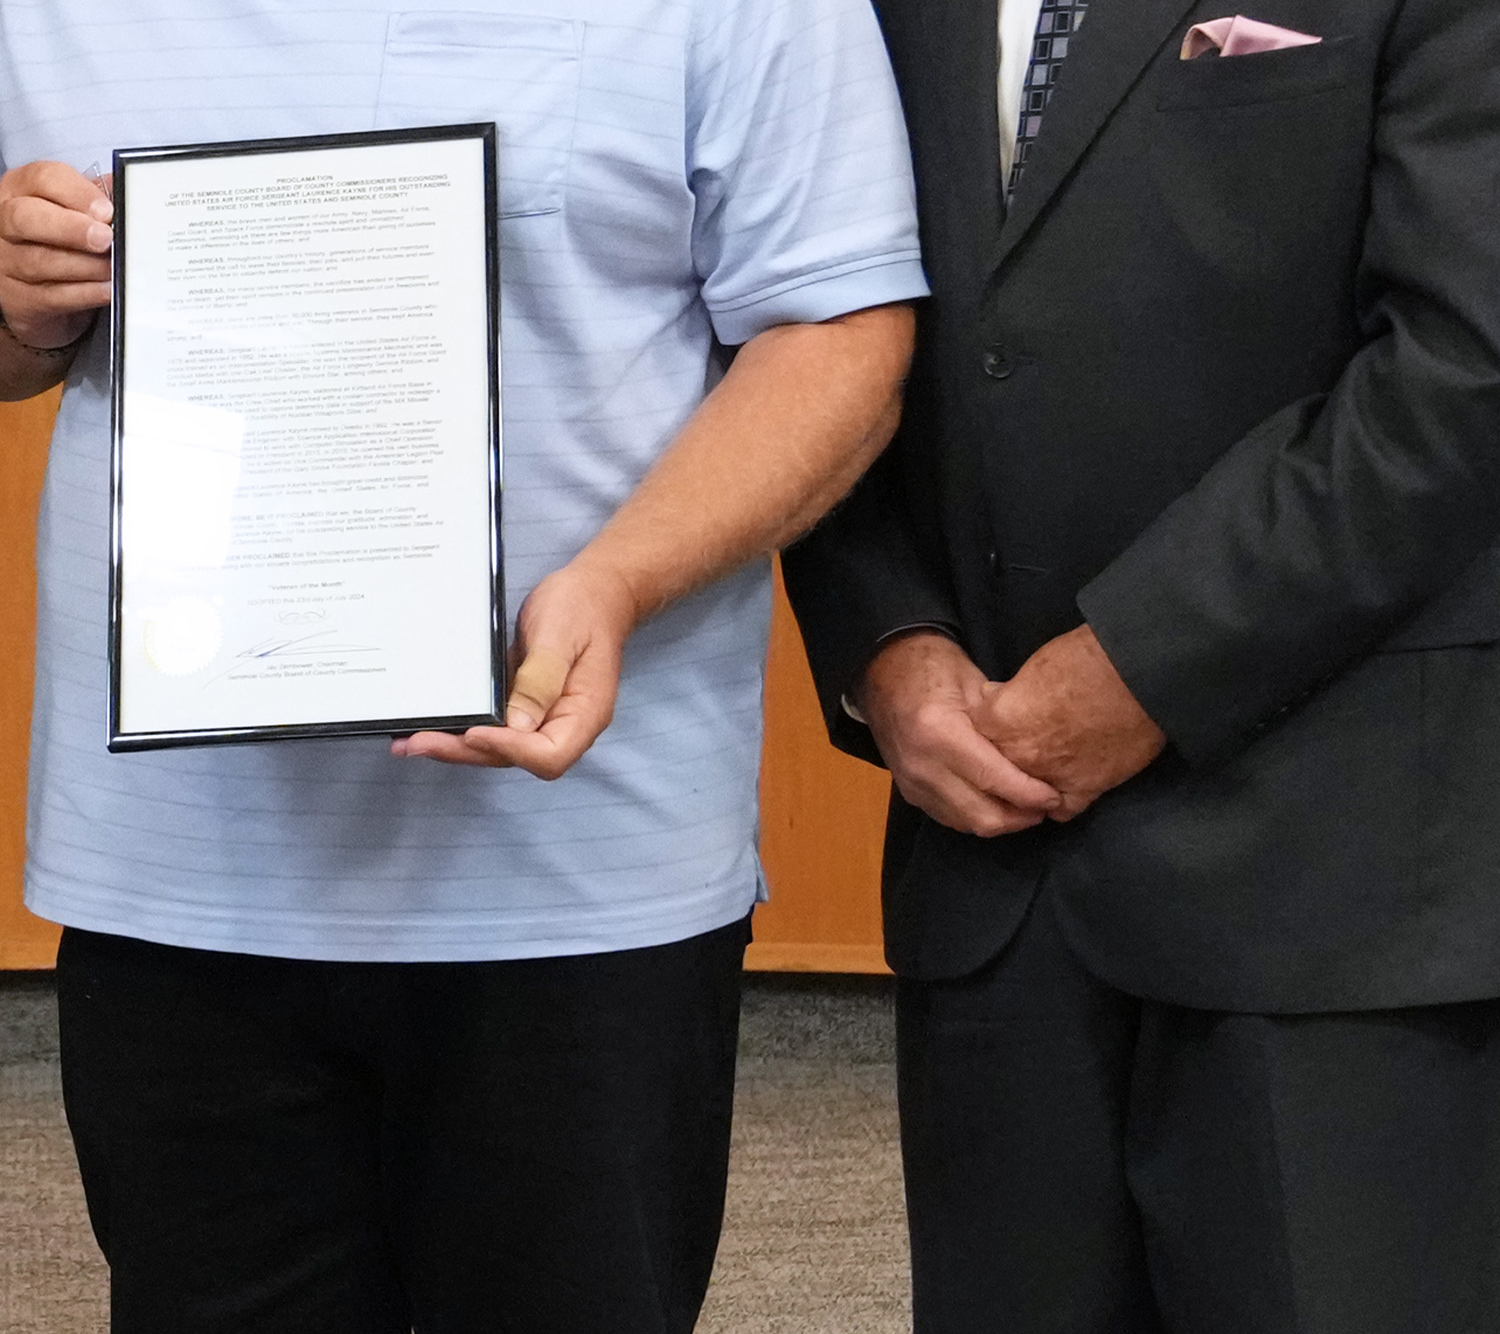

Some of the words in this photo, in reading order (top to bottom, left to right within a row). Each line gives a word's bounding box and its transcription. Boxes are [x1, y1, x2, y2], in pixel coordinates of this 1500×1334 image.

[196, 189, 233, 197] SEMINOLE
[334, 177, 397, 187] COMMISSIONERS
[397, 174, 448, 182] RECOGNIZING
[275, 175, 333, 184] PROCLAMATION
[260, 192, 300, 200] SERGEANT
[301, 189, 340, 197] LAURENCE
[398, 181, 451, 190] OUTSTANDING
[378, 191, 408, 199] COUNTY
